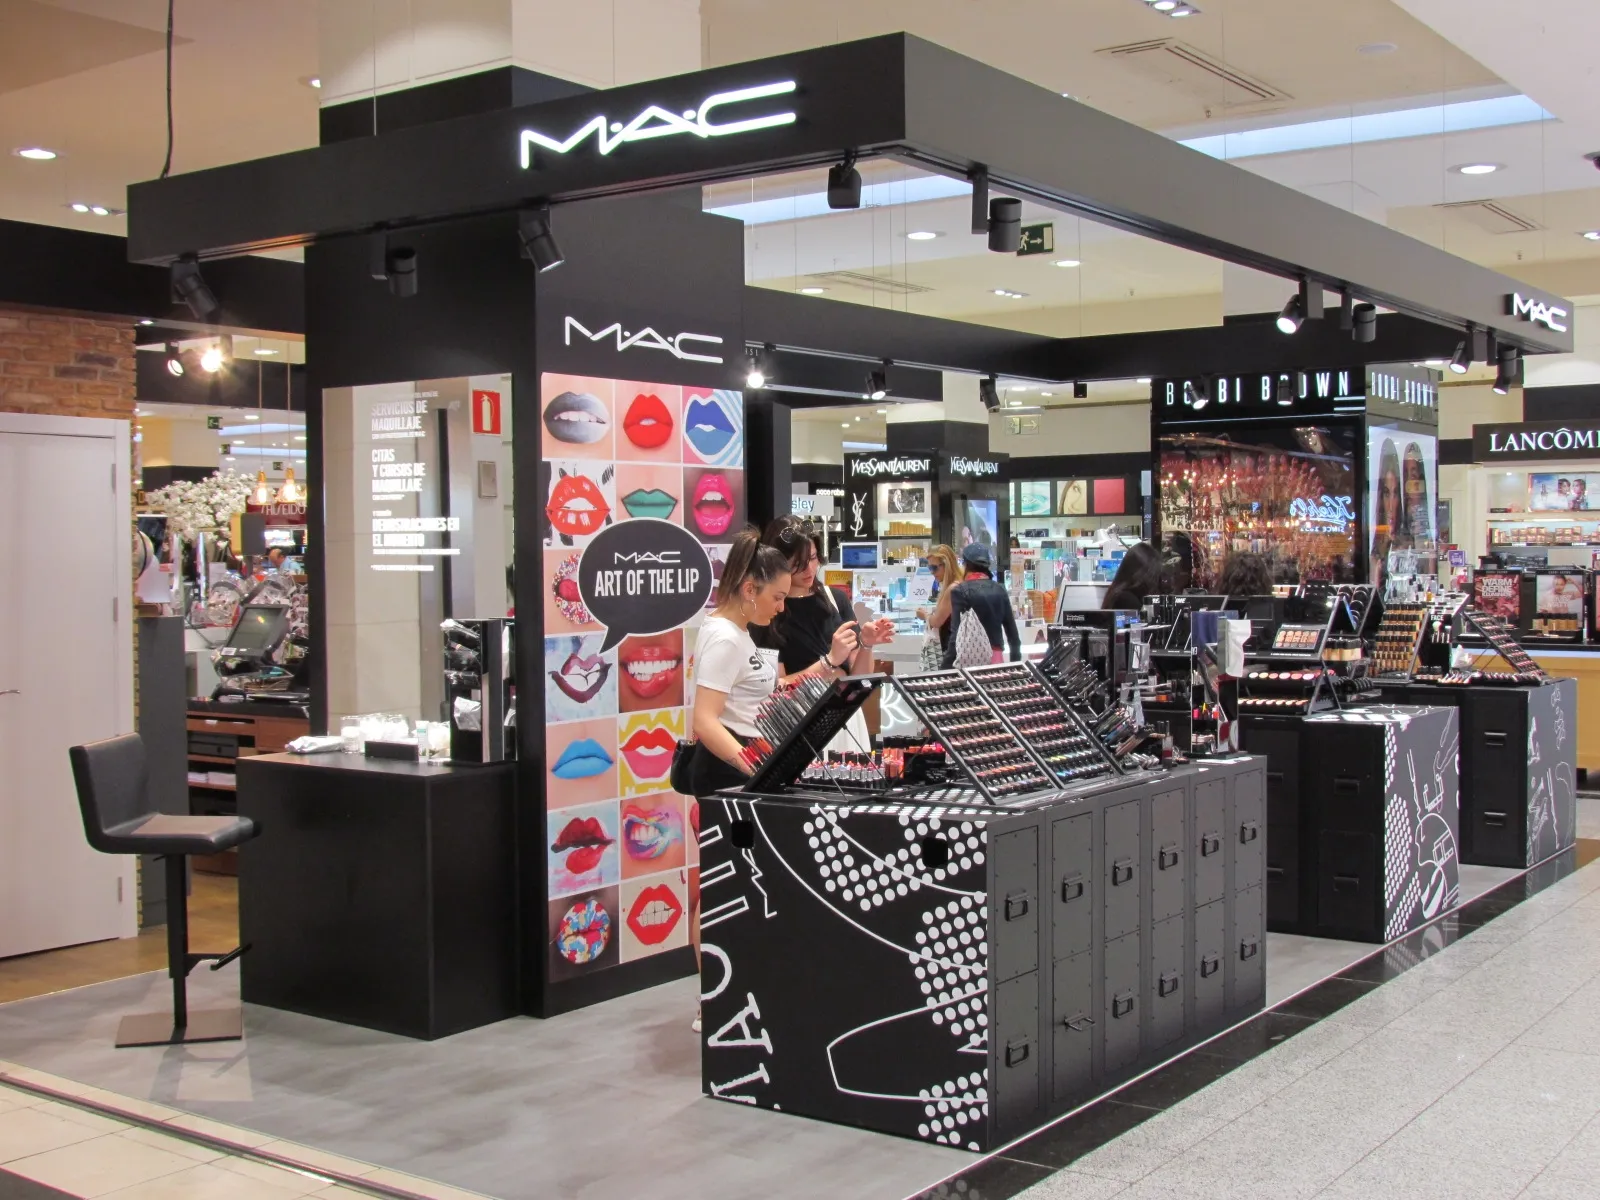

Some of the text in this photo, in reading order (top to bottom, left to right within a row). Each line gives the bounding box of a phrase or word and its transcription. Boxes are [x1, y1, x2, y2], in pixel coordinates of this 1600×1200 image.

[416, 400, 428, 414] DE
[371, 415, 422, 431] MAQUILLAJE
[371, 448, 395, 462] CITAS
[372, 464, 379, 477] Y
[413, 462, 426, 476] DE
[594, 568, 700, 597] ART OF THE LIP
[1482, 578, 1513, 586] WARM
